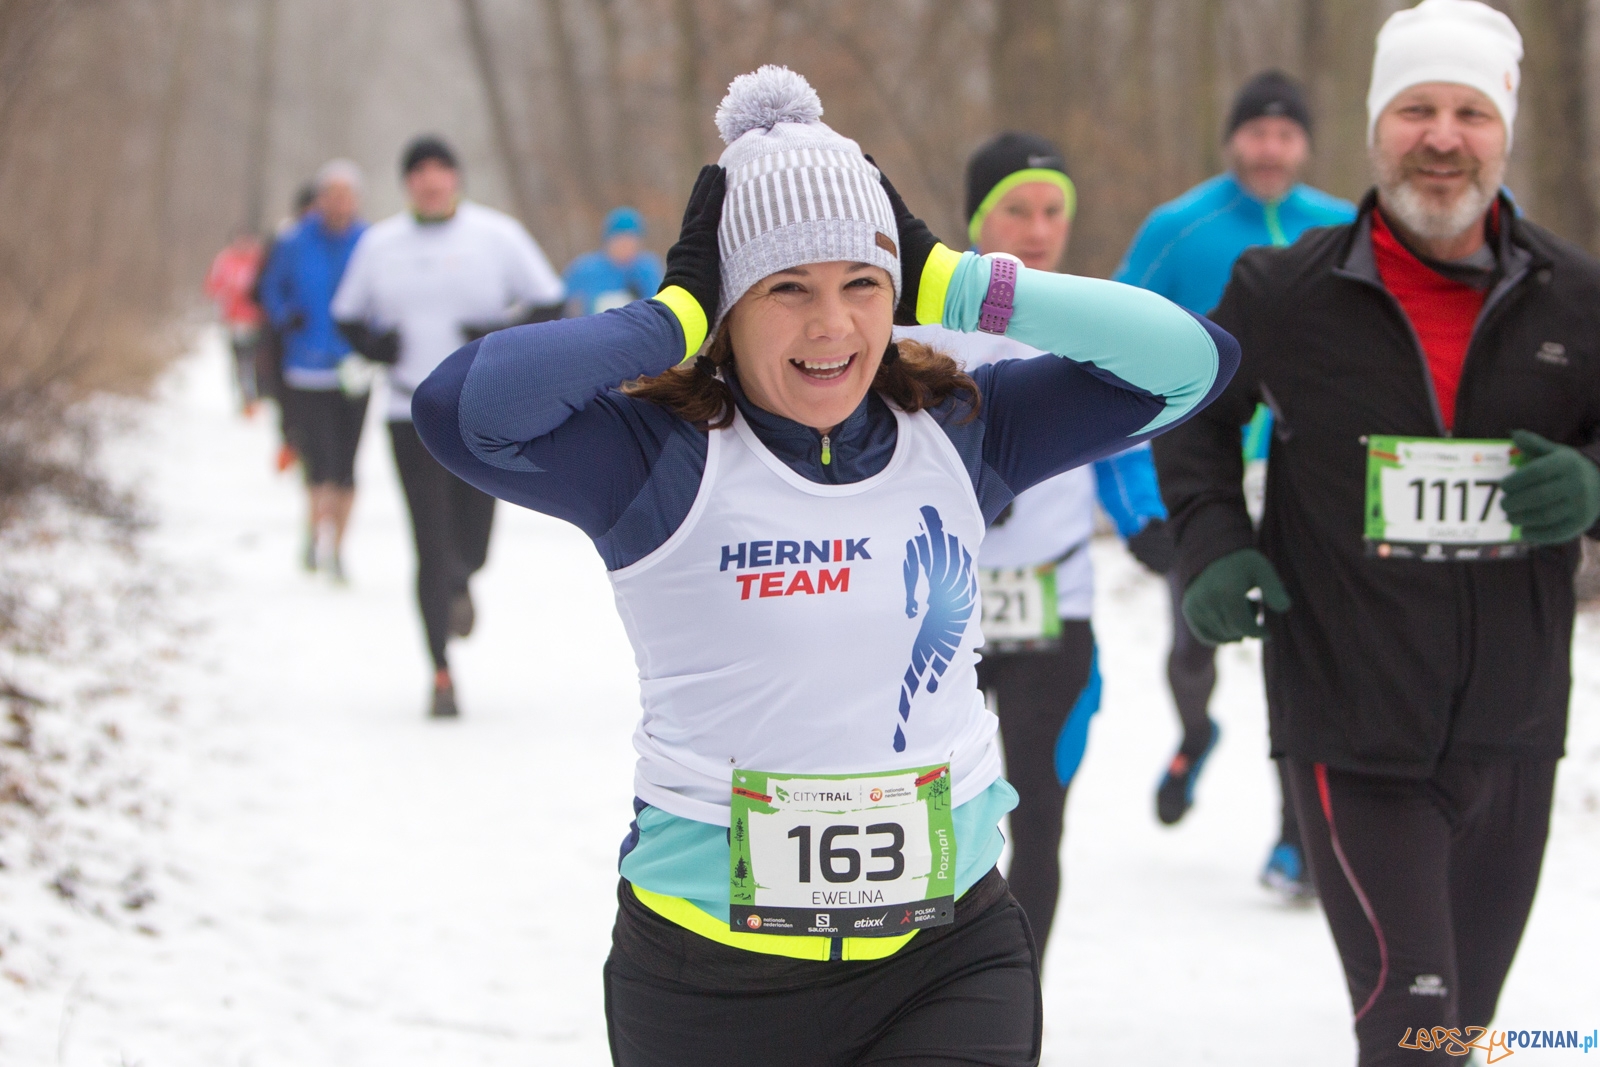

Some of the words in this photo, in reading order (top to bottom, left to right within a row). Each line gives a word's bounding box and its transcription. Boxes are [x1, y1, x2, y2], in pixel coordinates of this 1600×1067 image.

[1408, 477, 1501, 522] 1117
[719, 537, 873, 571] HERNIK
[736, 567, 850, 600] TEAM
[981, 590, 1027, 622] 21
[884, 791, 912, 799] nederlanden
[787, 822, 905, 884] 163
[937, 829, 948, 880] Poznań
[812, 889, 884, 905] EWELINA
[914, 907, 936, 916] POLSKA
